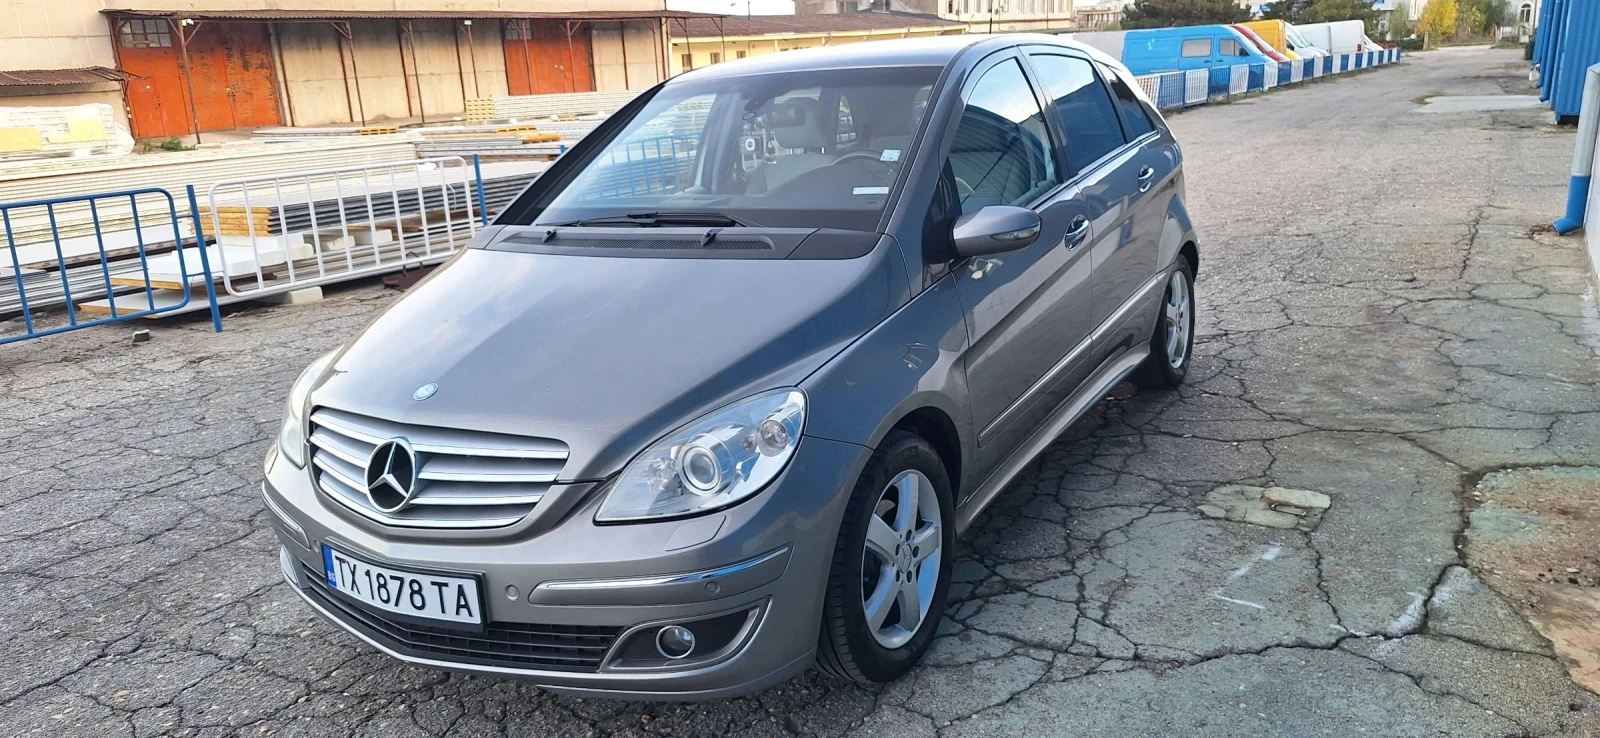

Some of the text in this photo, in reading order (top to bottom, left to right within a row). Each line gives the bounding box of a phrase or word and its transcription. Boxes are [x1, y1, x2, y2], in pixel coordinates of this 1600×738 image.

[335, 555, 473, 617] TX 1878 TA
